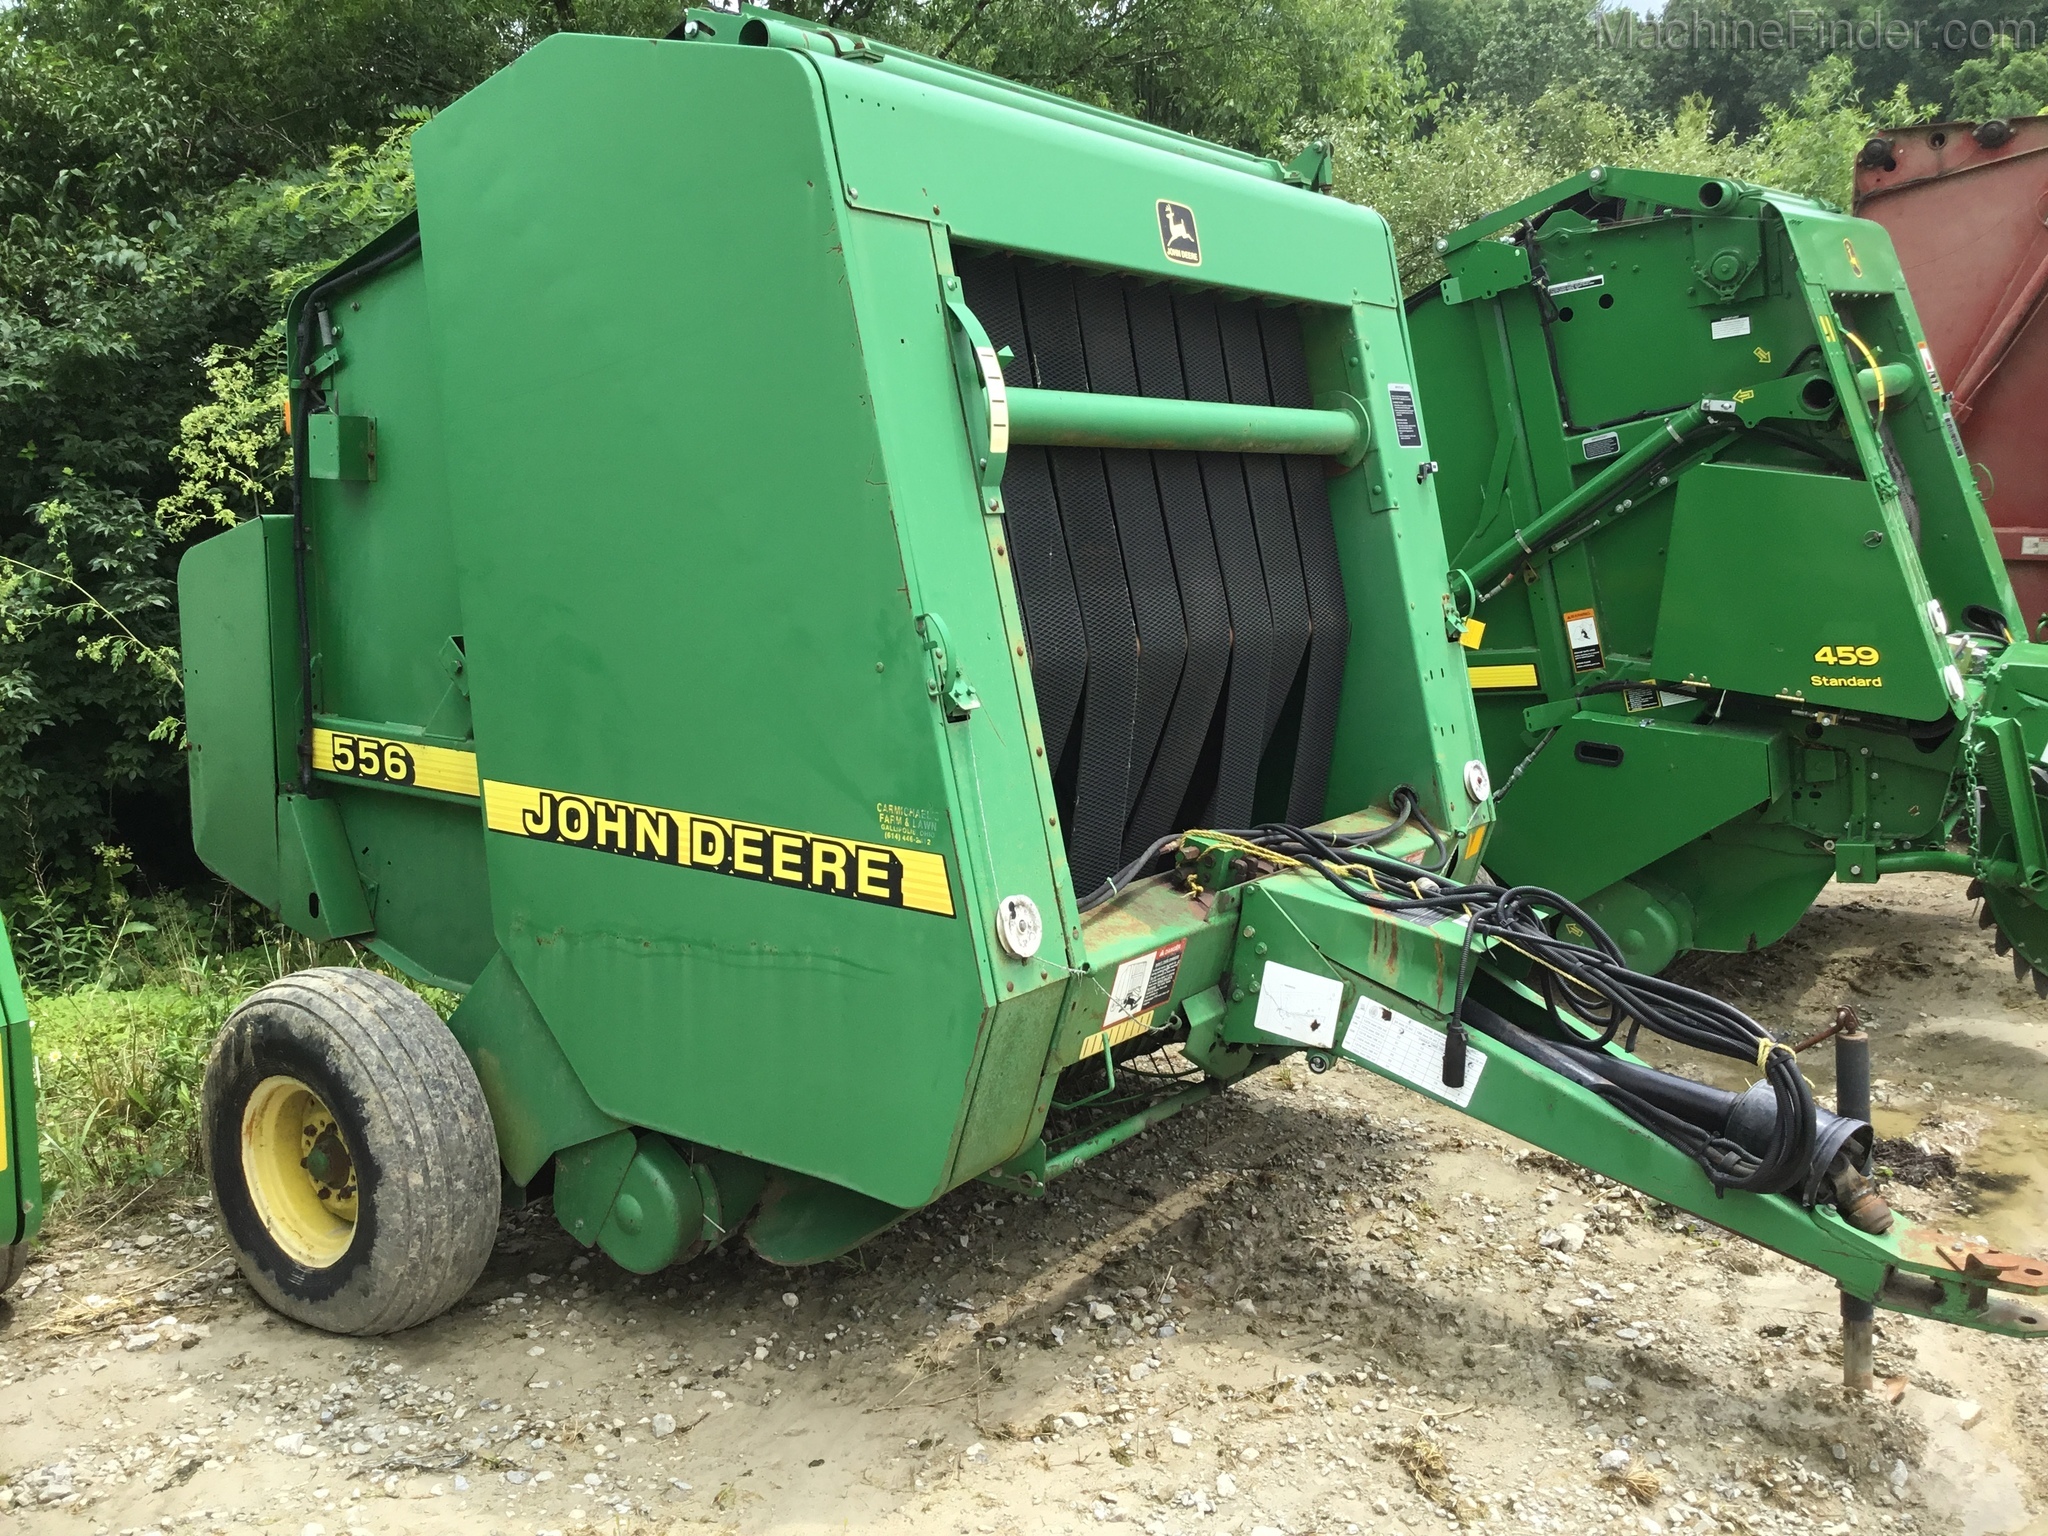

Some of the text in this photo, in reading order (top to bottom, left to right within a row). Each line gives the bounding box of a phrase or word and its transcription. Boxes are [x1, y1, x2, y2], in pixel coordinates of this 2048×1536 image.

[1814, 646, 1880, 667] 459
[1810, 675, 1883, 687] Standard
[333, 735, 412, 782] 556
[879, 813, 937, 832] FARM & LAWN
[884, 831, 901, 842] (614)
[523, 794, 897, 903] JOHN DEERE
